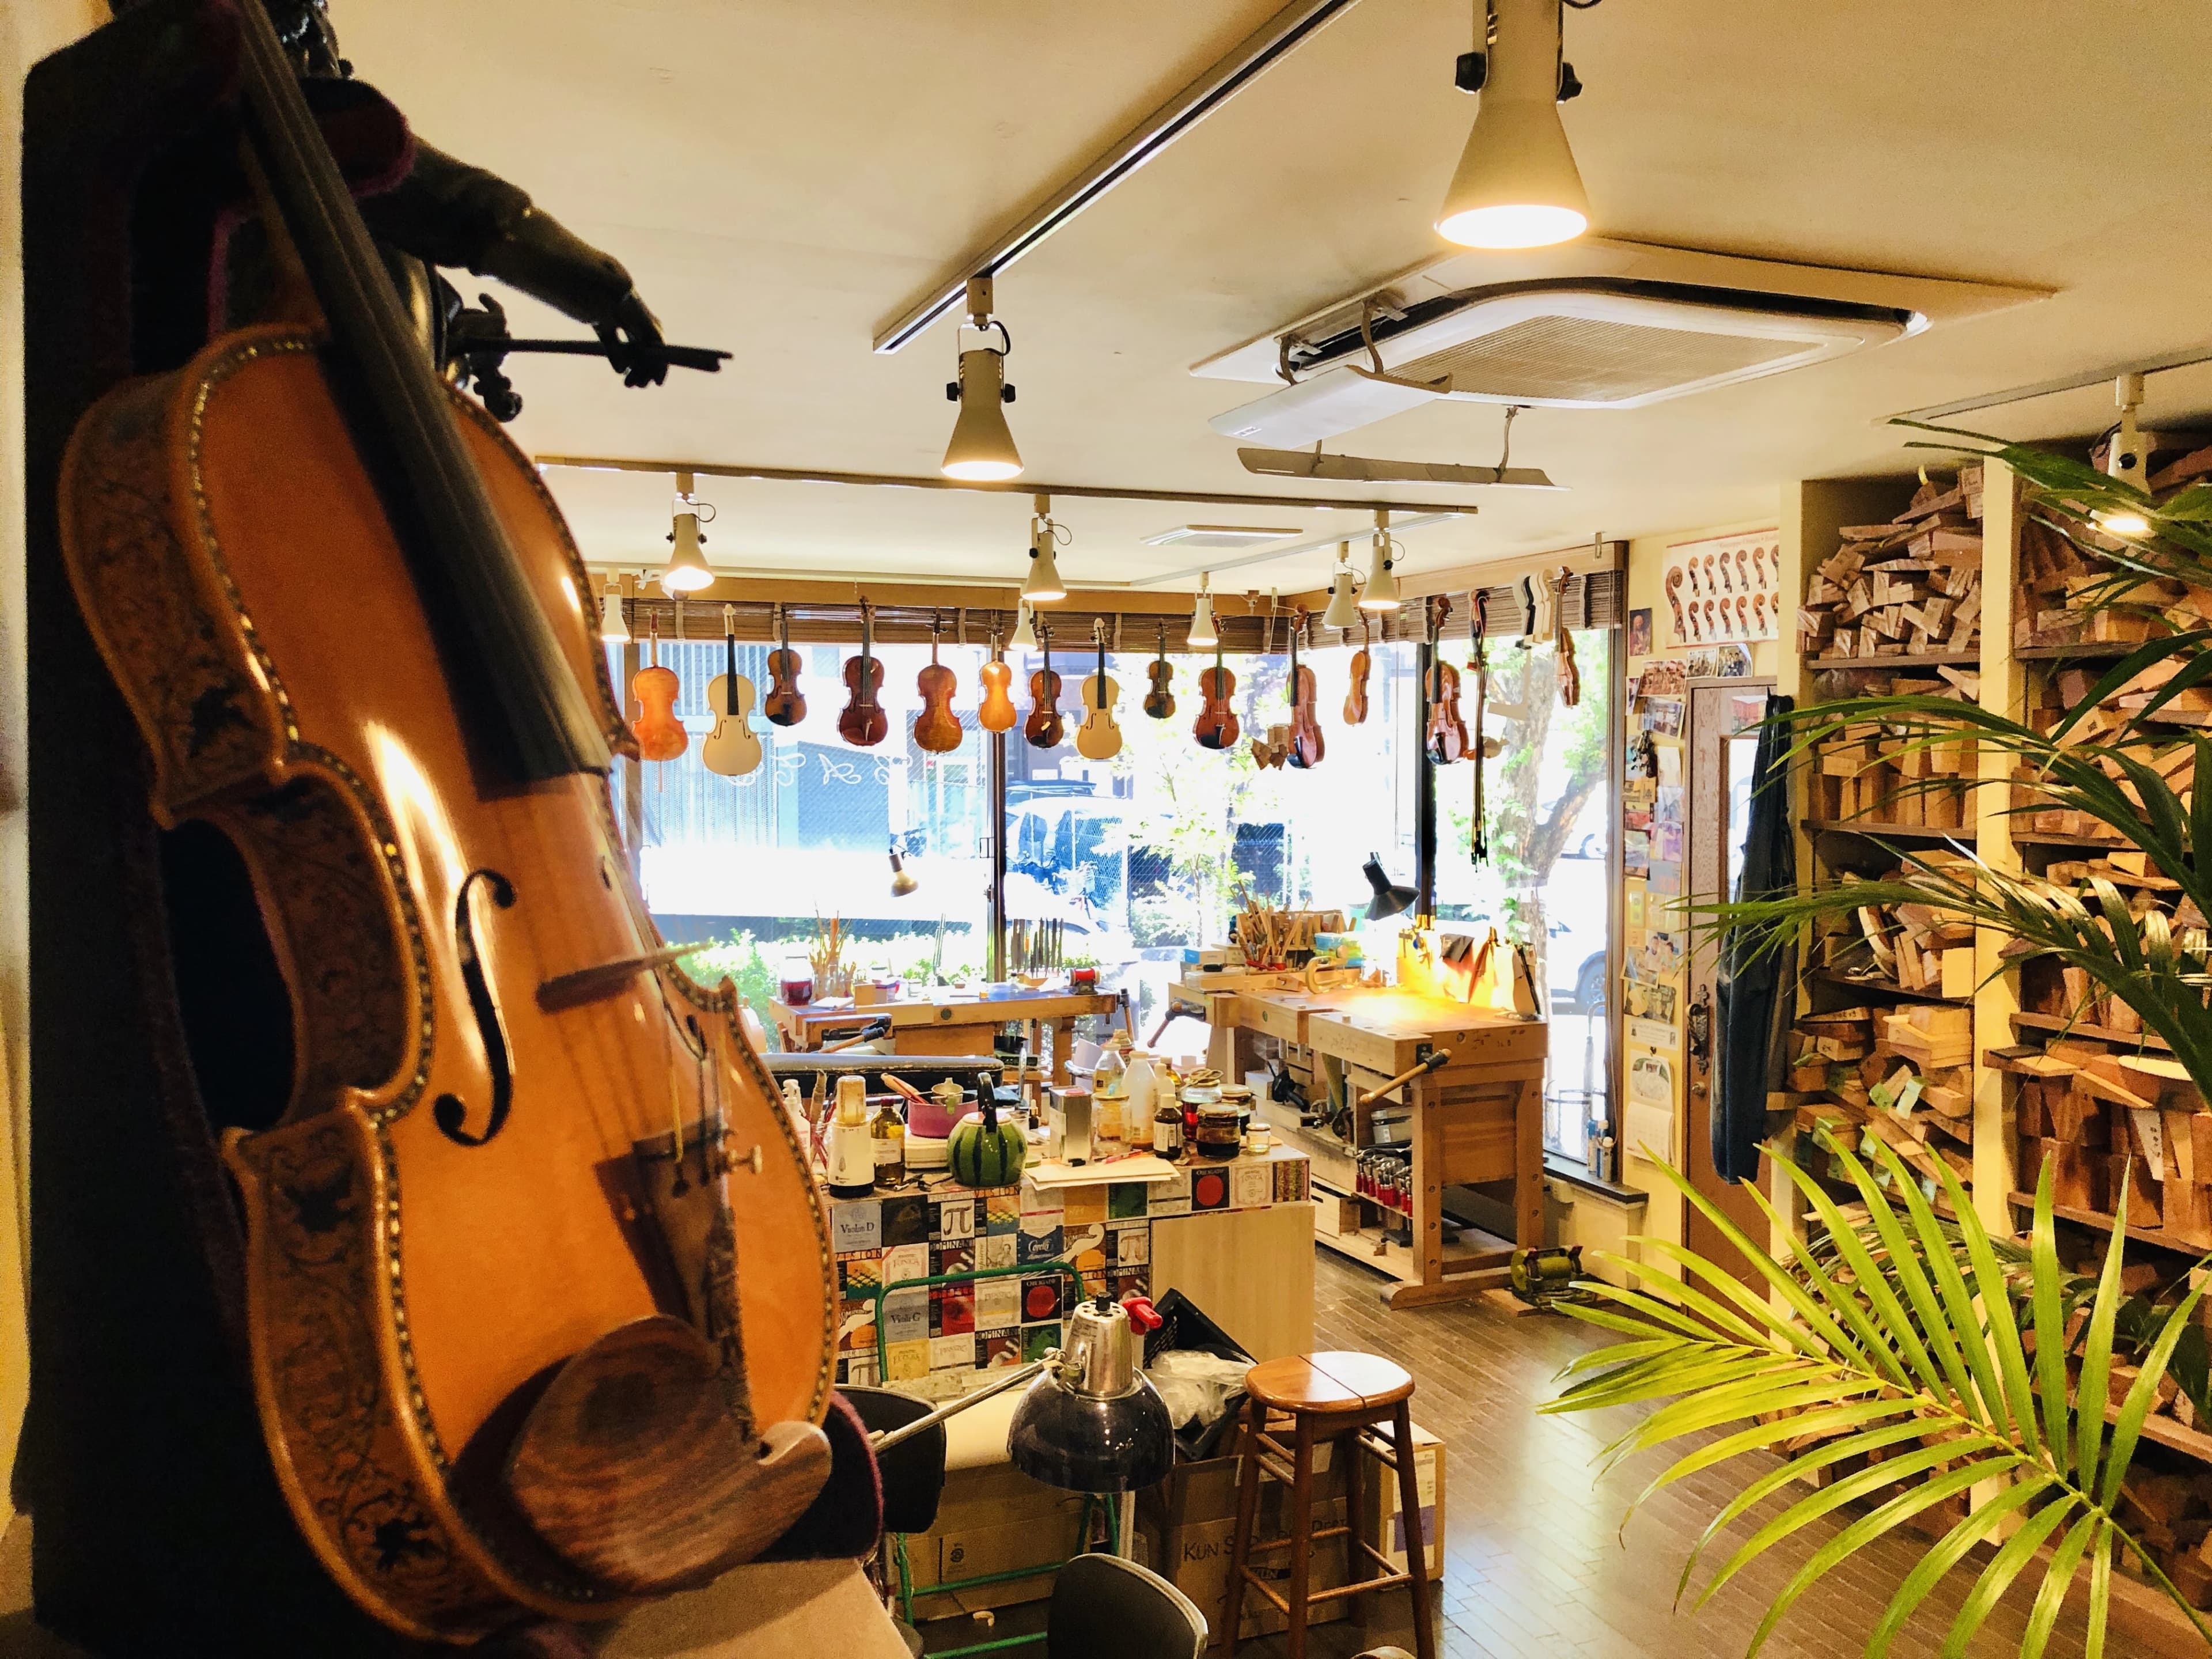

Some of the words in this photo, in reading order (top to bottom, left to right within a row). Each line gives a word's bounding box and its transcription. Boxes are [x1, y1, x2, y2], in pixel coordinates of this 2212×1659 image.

[975, 1186, 1020, 1198] VISION
[866, 1222, 875, 1232] D
[1183, 1542, 1219, 1562] KUN
